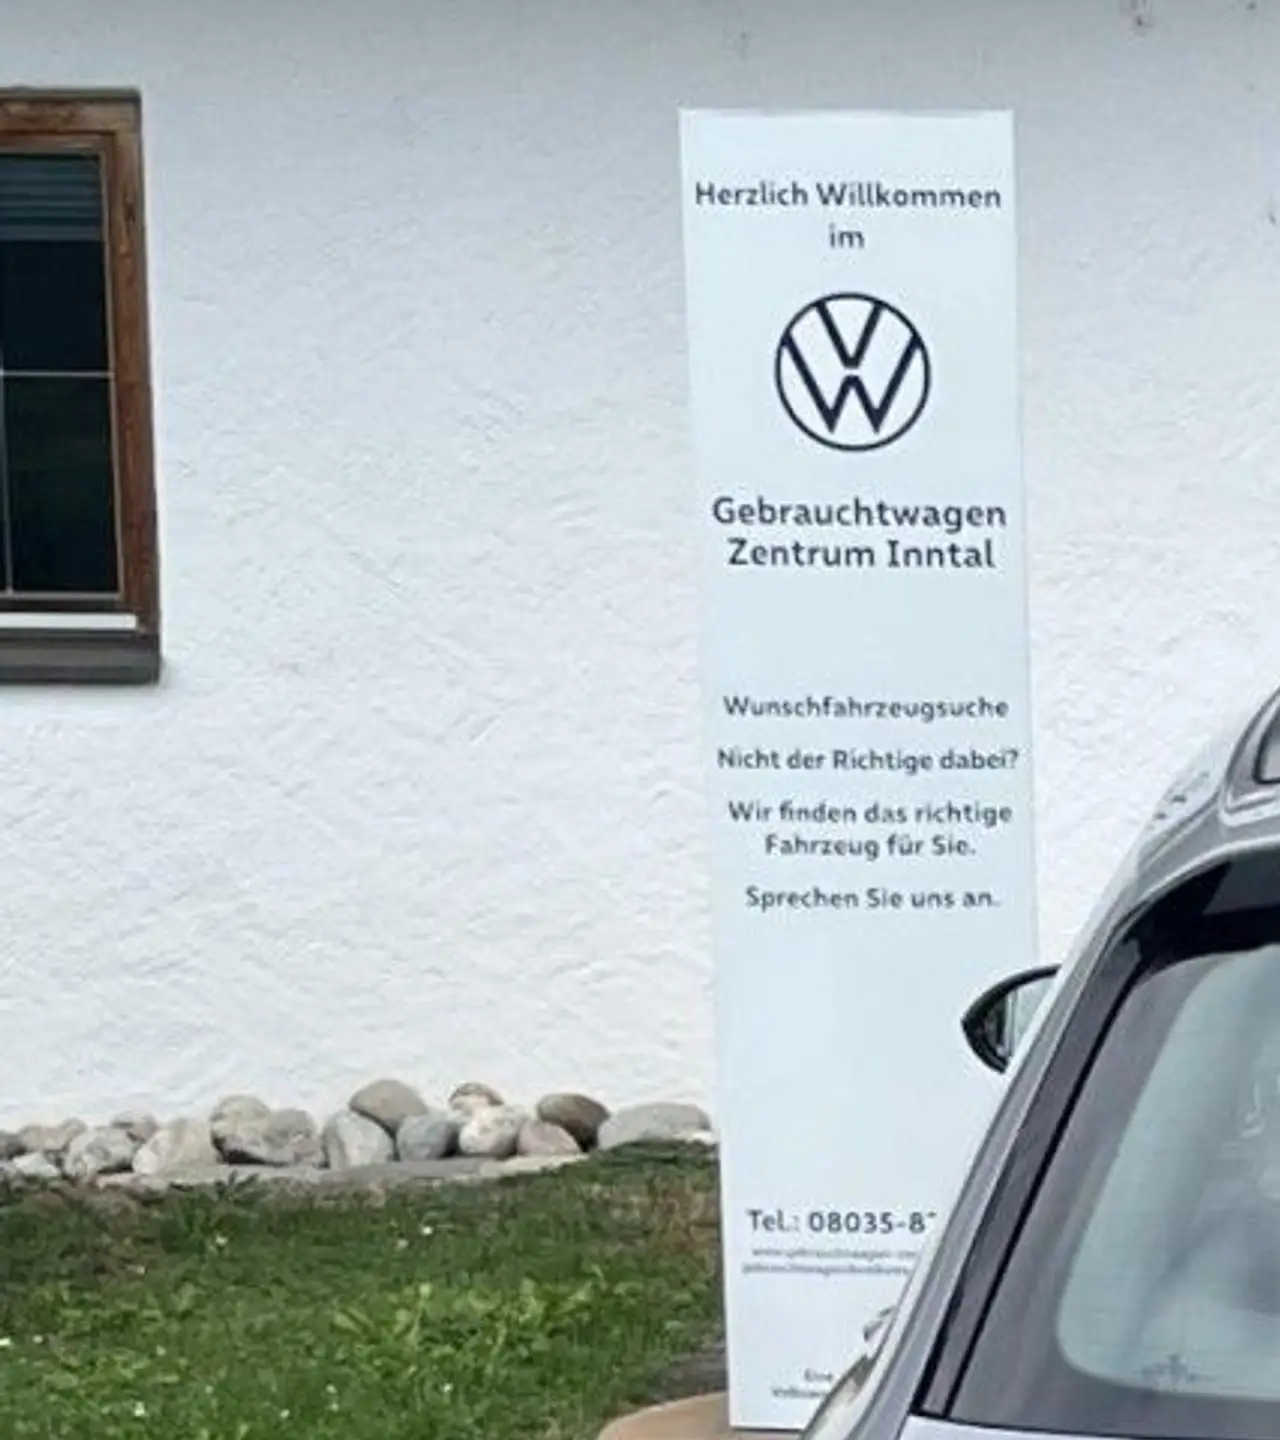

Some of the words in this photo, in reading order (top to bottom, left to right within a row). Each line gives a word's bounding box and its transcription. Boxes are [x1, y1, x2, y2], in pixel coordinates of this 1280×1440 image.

[695, 181, 808, 207] Herzlich
[815, 182, 1002, 209] Willkommen
[829, 225, 866, 249] im
[712, 495, 1007, 533] Gebrauchtwagen
[728, 537, 877, 569] Zentrum
[886, 539, 996, 570] Inntal
[723, 695, 1010, 723] Wunschfahrzeugsuche
[717, 748, 781, 770] Nicht
[785, 748, 826, 770] der
[832, 748, 934, 776] Richtige
[938, 748, 1019, 770] dabei?
[727, 800, 773, 823] Wir
[777, 800, 858, 824] finden
[863, 800, 909, 824] das
[914, 800, 1013, 828] richtige
[764, 833, 880, 861] Fahrzeug
[886, 833, 925, 856] für
[931, 834, 978, 857] Sie.
[745, 885, 859, 914] Sprechen
[864, 886, 903, 909] Sie
[910, 891, 955, 909] uns
[961, 891, 1003, 909] an.
[747, 1208, 801, 1233] Tel.:
[808, 1211, 937, 1234] 08035-8
